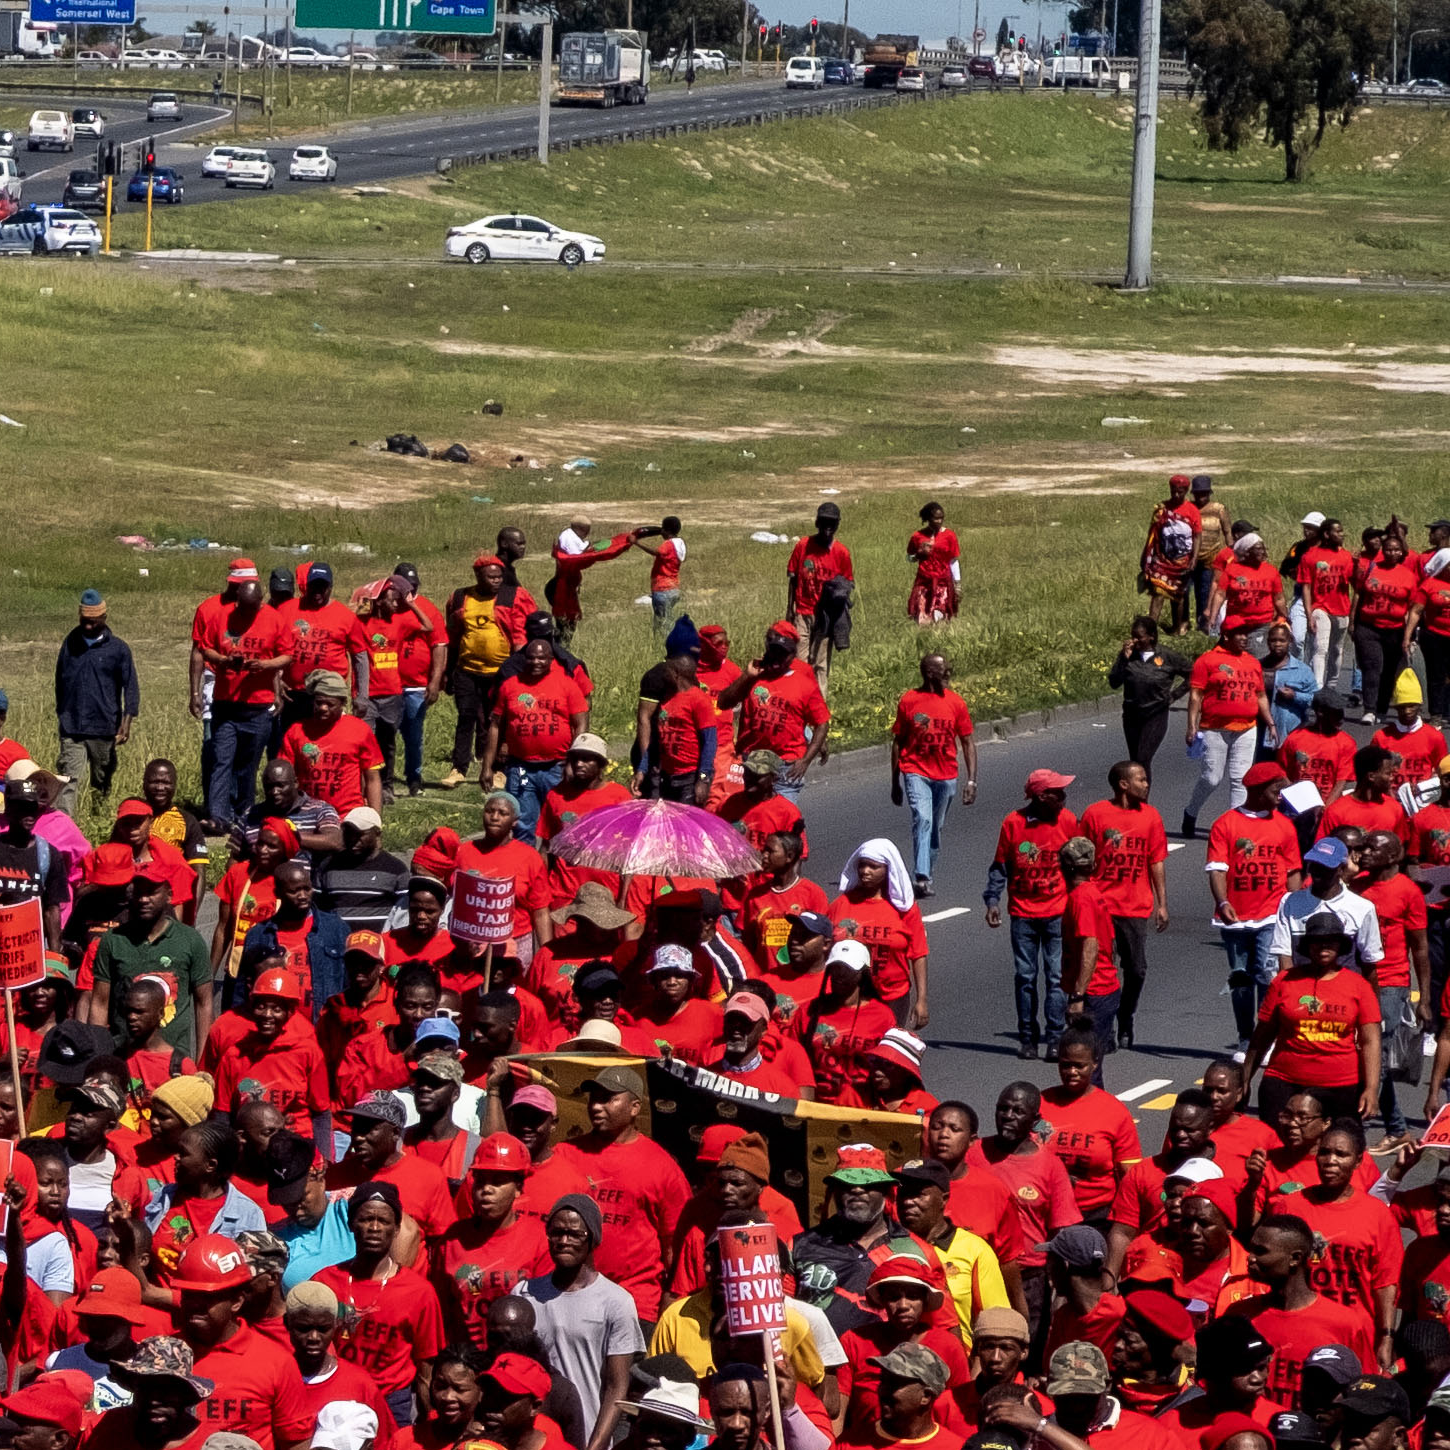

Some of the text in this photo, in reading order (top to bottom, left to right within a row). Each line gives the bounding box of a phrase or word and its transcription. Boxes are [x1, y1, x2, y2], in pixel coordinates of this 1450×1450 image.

[55, 8, 130, 19] Somerset West
[430, 4, 485, 16] Cape Town
[519, 712, 560, 723] VOTE
[1104, 854, 1144, 868] VOTE
[1105, 868, 1142, 884] EFF
[1235, 862, 1277, 876] VOTE
[477, 881, 513, 895] STOP
[1235, 878, 1275, 892] EFF
[477, 911, 509, 925] TAXI
[350, 932, 379, 946] EFF
[1057, 1131, 1095, 1148] EFF
[364, 1320, 398, 1341] EFF
[206, 1398, 253, 1420] EFF
